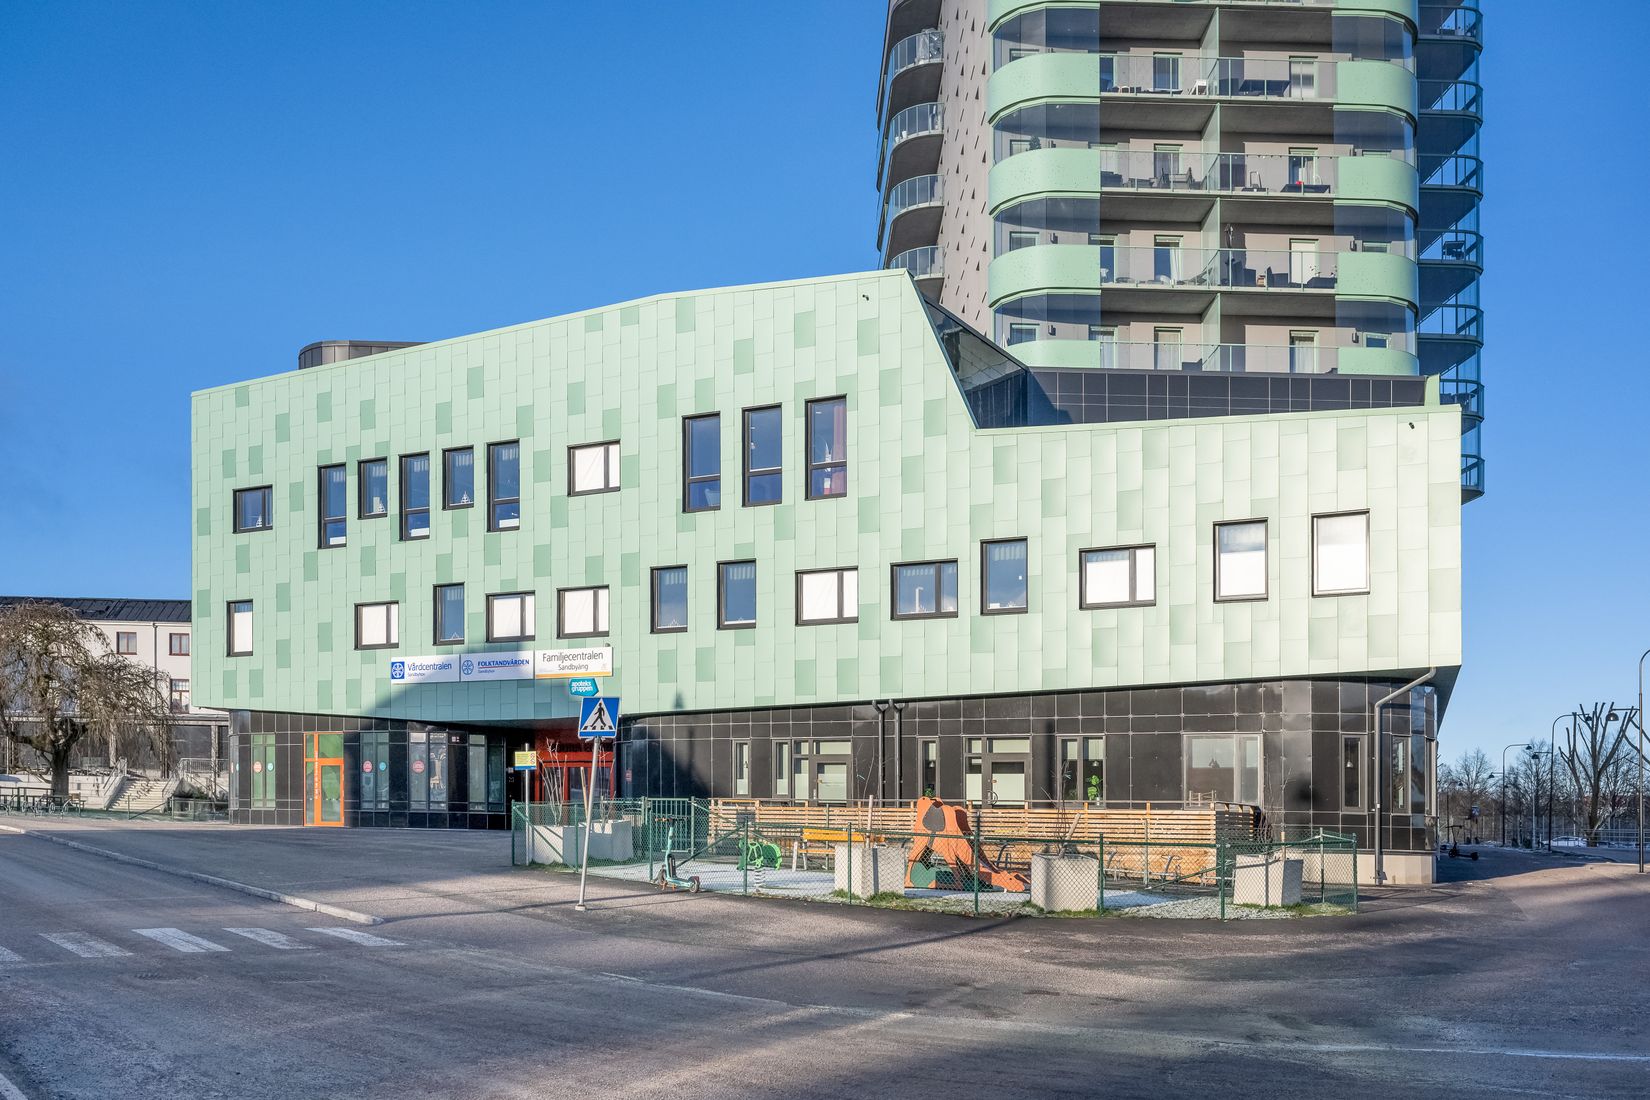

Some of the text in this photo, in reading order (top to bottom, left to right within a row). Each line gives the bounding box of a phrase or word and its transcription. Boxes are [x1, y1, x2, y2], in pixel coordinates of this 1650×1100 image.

[542, 650, 604, 664] Familjecentralen
[407, 662, 452, 672] Vårdcentralen
[477, 658, 530, 667] FOLKTANDVÅRDEN
